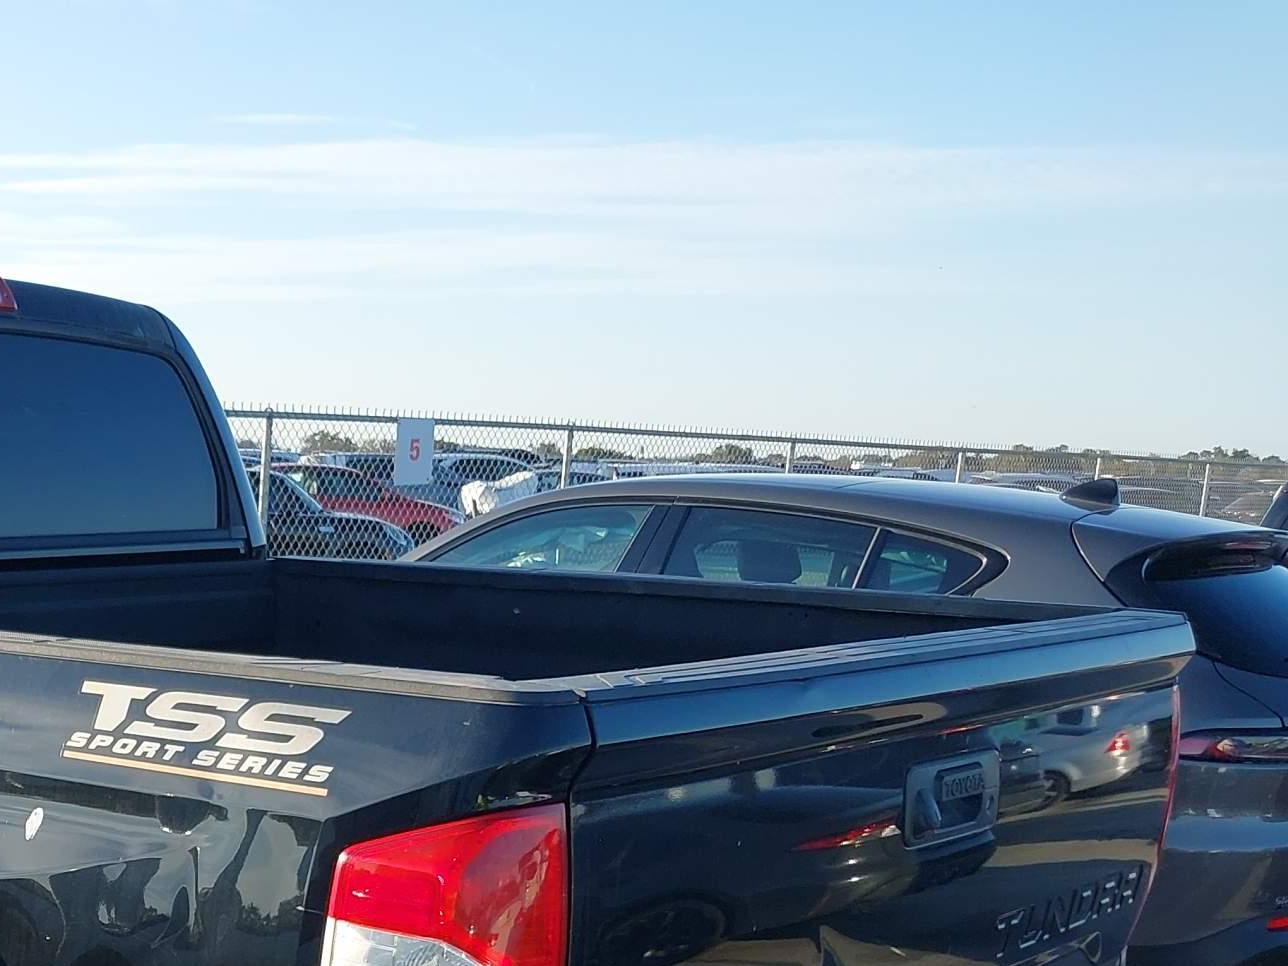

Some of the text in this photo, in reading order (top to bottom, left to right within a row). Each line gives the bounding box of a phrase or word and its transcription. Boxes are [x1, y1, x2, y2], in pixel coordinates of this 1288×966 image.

[408, 437, 421, 462] 5
[80, 680, 353, 756] TSS
[66, 731, 334, 783] SPORT SERIES
[942, 772, 985, 799] TOYOTA
